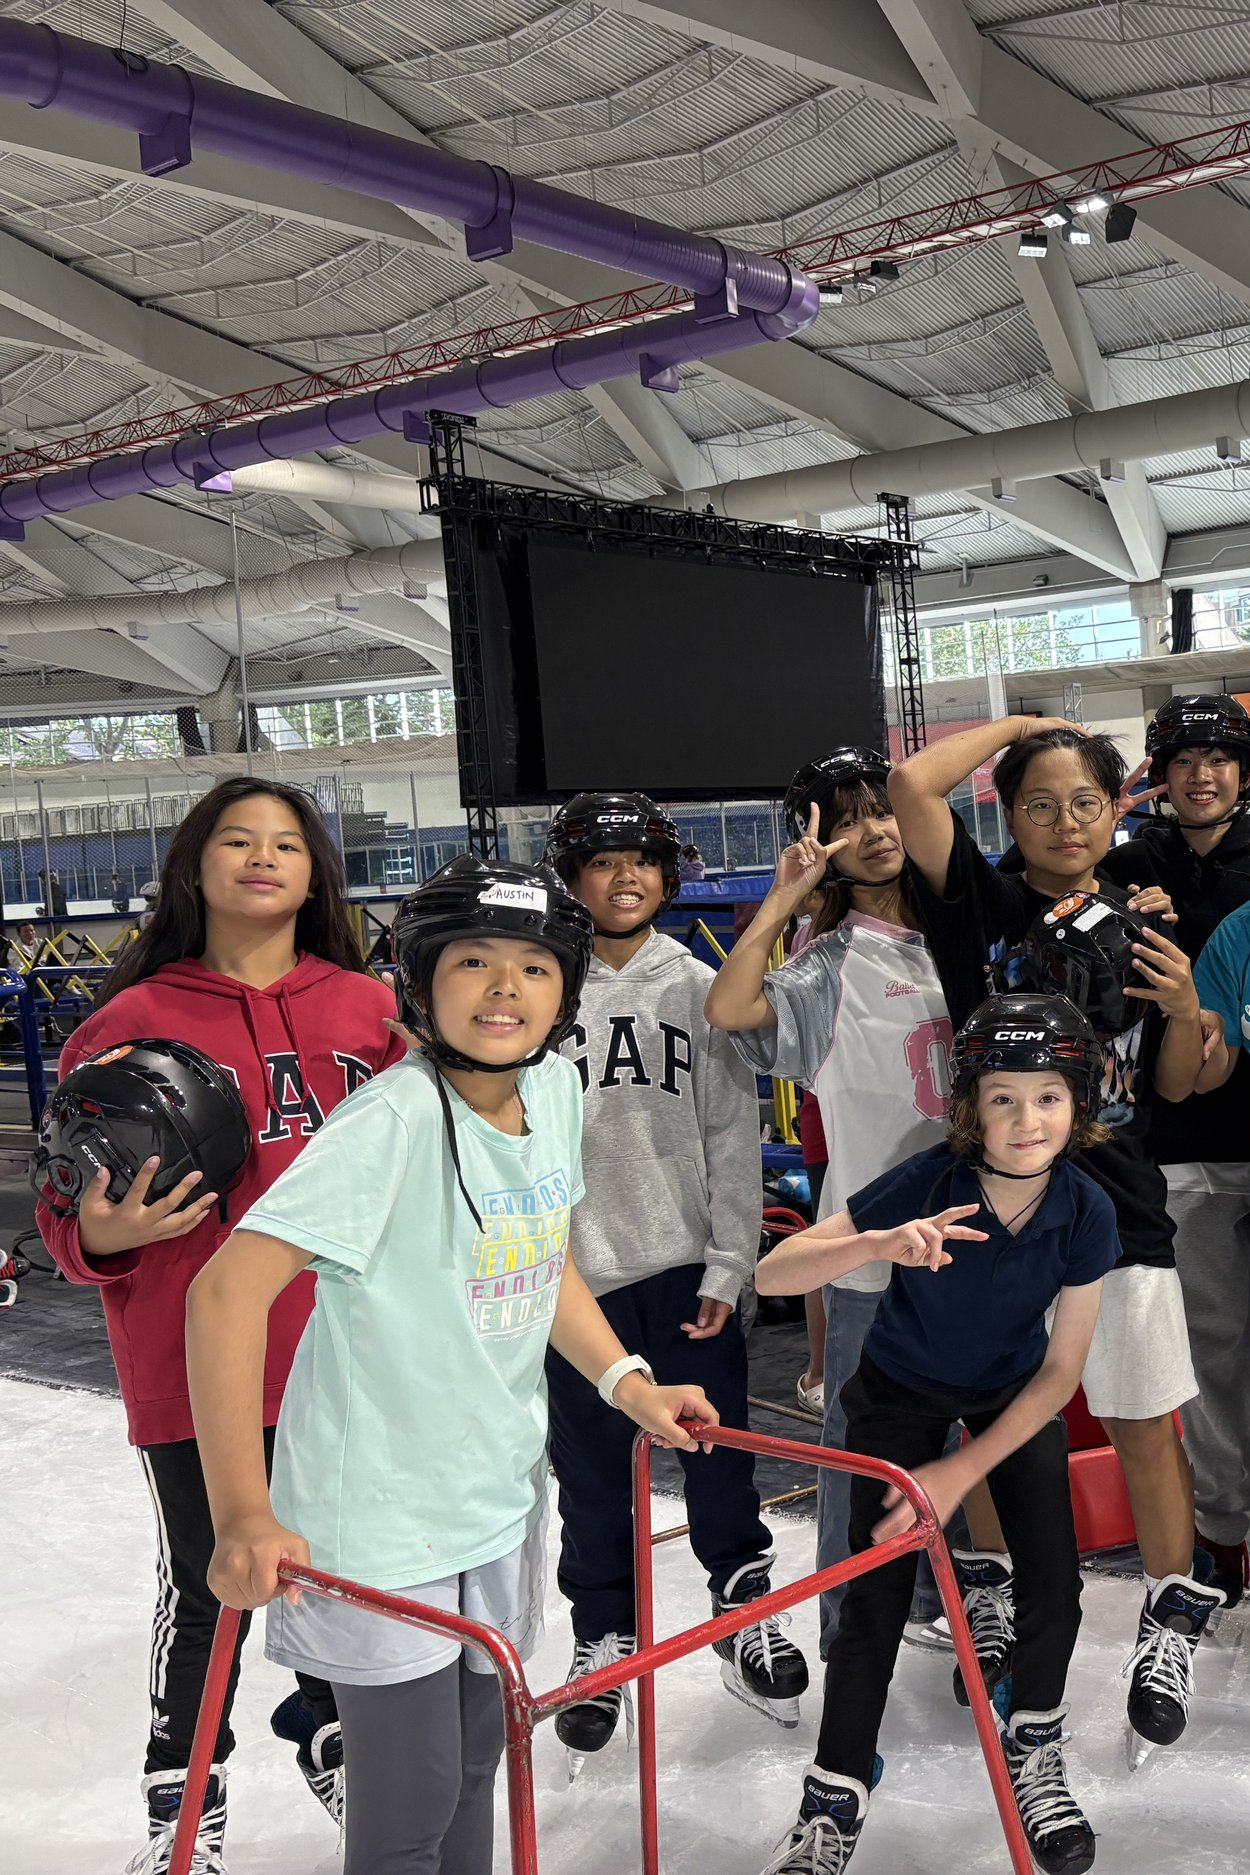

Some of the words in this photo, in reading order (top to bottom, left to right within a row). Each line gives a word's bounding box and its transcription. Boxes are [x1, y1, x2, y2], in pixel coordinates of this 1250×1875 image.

[1182, 713, 1219, 721] CCM
[596, 815, 639, 824] CCM
[496, 889, 535, 901] AUSTIN
[994, 1031, 1046, 1041] CCM
[1175, 1589, 1214, 1606] BAUER
[808, 1784, 850, 1801] BAUER
